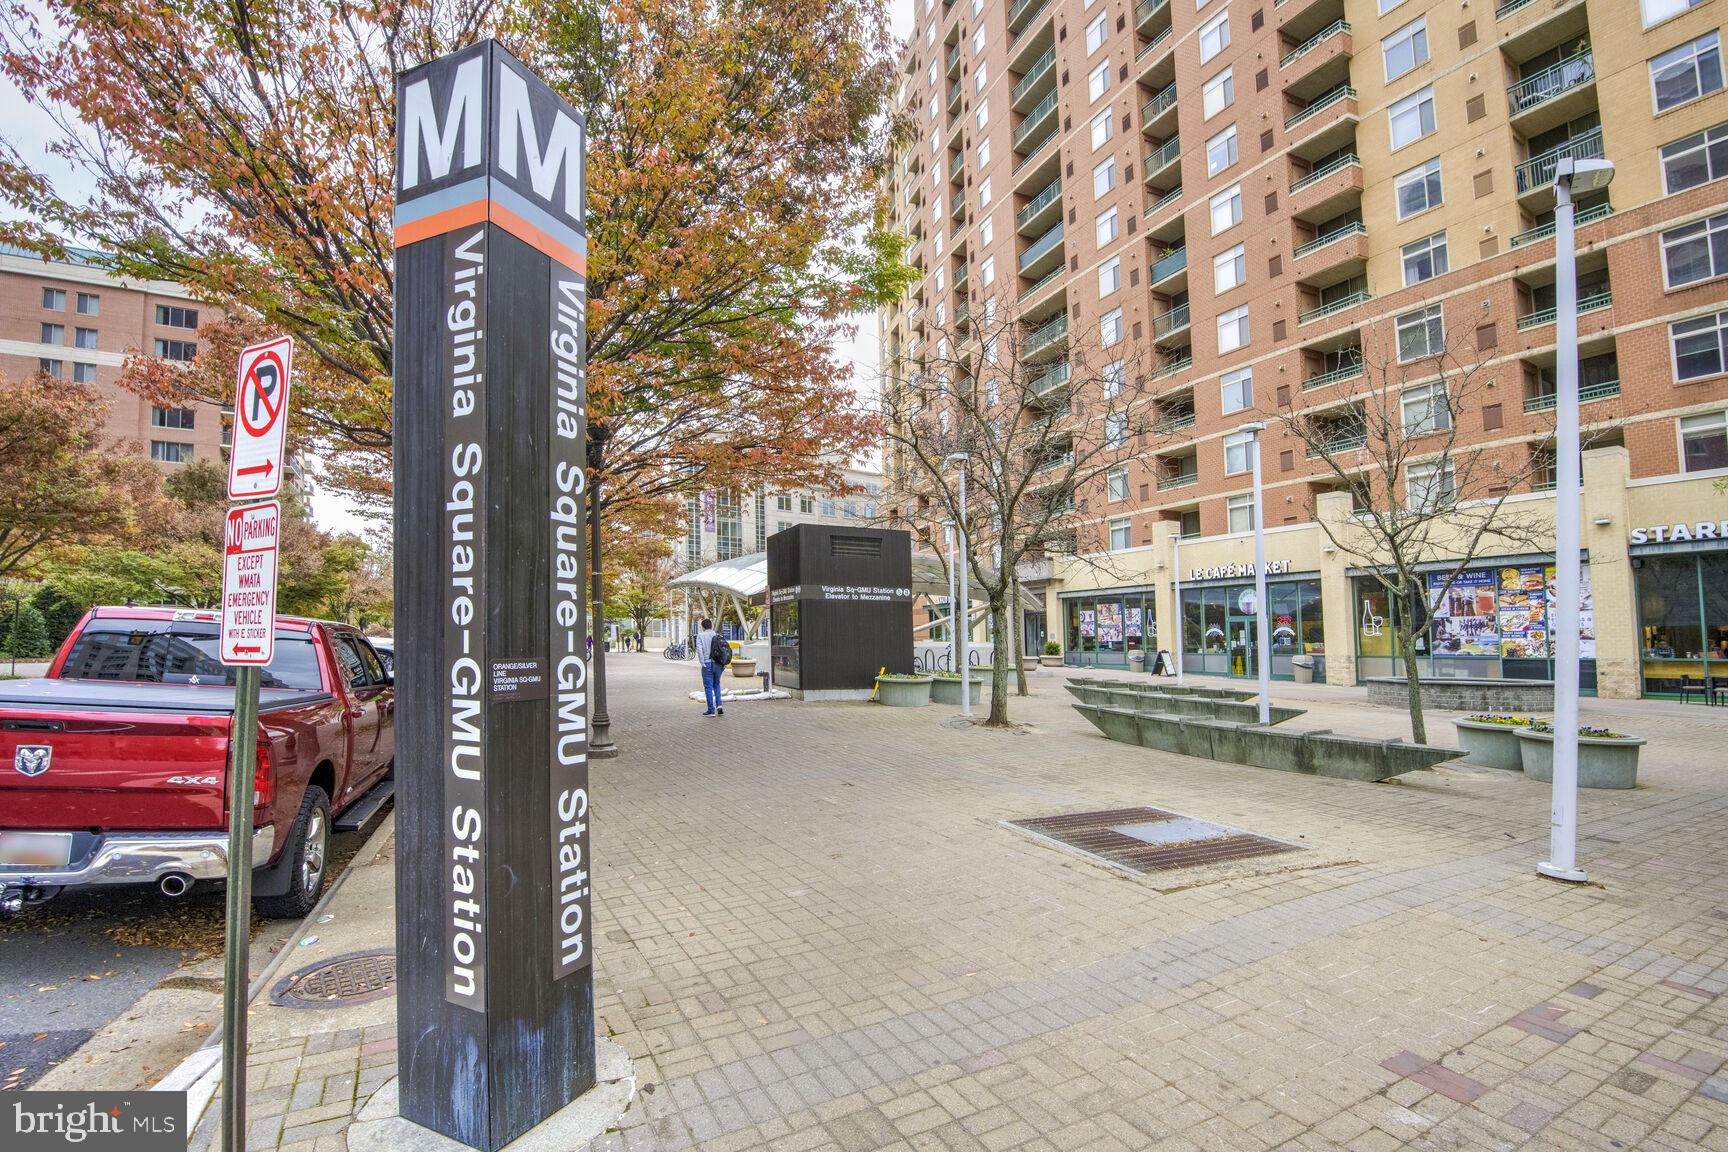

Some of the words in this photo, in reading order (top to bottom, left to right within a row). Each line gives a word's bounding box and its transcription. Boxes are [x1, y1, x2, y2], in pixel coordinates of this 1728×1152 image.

[402, 55, 483, 191] M
[498, 60, 581, 222] M
[447, 229, 485, 418] Virginia
[550, 279, 585, 440] Virginia
[227, 517, 242, 547] NO
[243, 516, 275, 539] PARKING
[237, 554, 264, 571] EXCEPT
[1189, 568, 1204, 580] LE
[1205, 562, 1235, 579] CAFÉ
[1238, 560, 1291, 577] MAKET
[238, 574, 261, 588] WMATA
[1465, 571, 1486, 579] WINE
[821, 585, 844, 593] Virginia
[846, 586, 871, 594] Sq-GMU
[227, 590, 270, 608] EMERGENCY
[233, 609, 262, 625] VEHICLE
[228, 628, 240, 639] WITH
[246, 627, 267, 639] STICKER
[493, 662, 538, 670] ORANGE/SILVER
[493, 676, 519, 684] VIRGINIA
[493, 684, 517, 692] STATION
[557, 787, 590, 966] Station
[451, 805, 482, 997] Station
